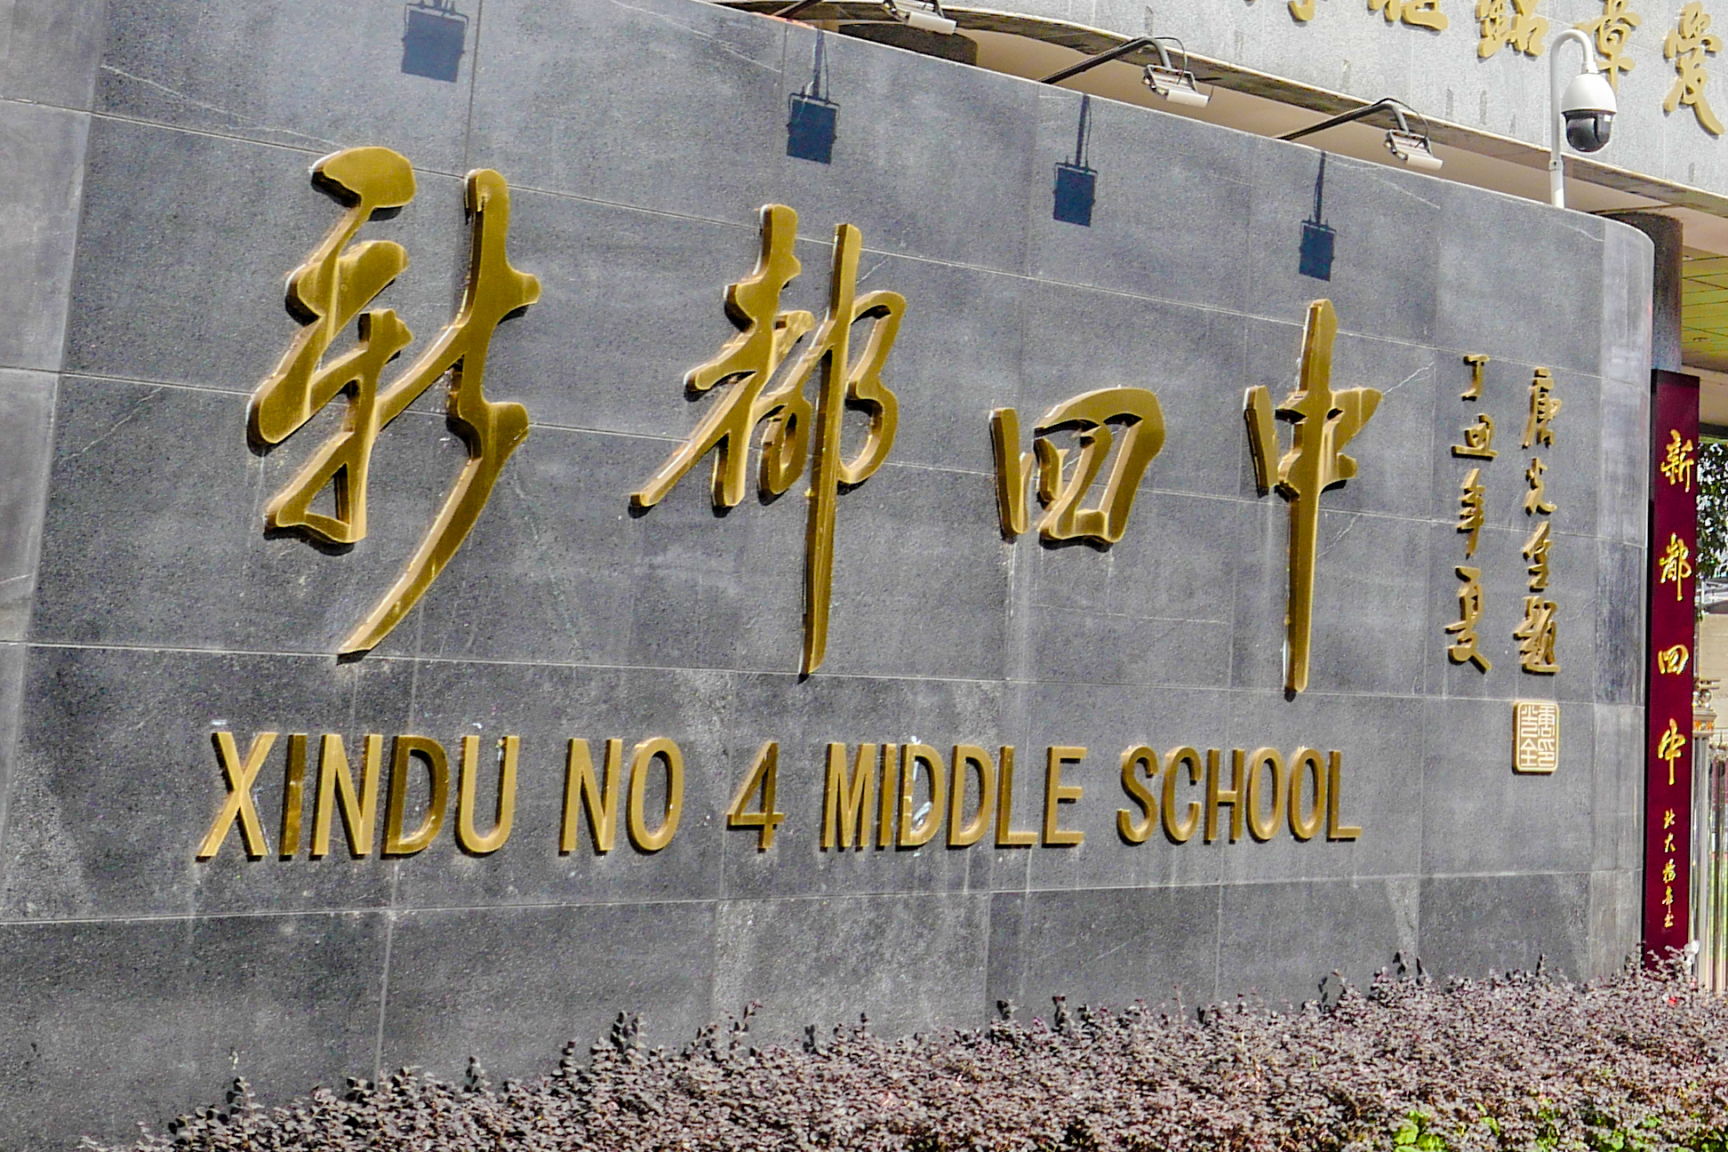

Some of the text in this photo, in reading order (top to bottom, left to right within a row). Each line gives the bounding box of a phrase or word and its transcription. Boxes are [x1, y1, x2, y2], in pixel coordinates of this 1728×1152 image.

[247, 146, 1383, 690] 新都四中
[1658, 429, 1694, 786] 新都四中
[197, 732, 1362, 857] XINDU NO 4 MIDDLE SCHOOL
